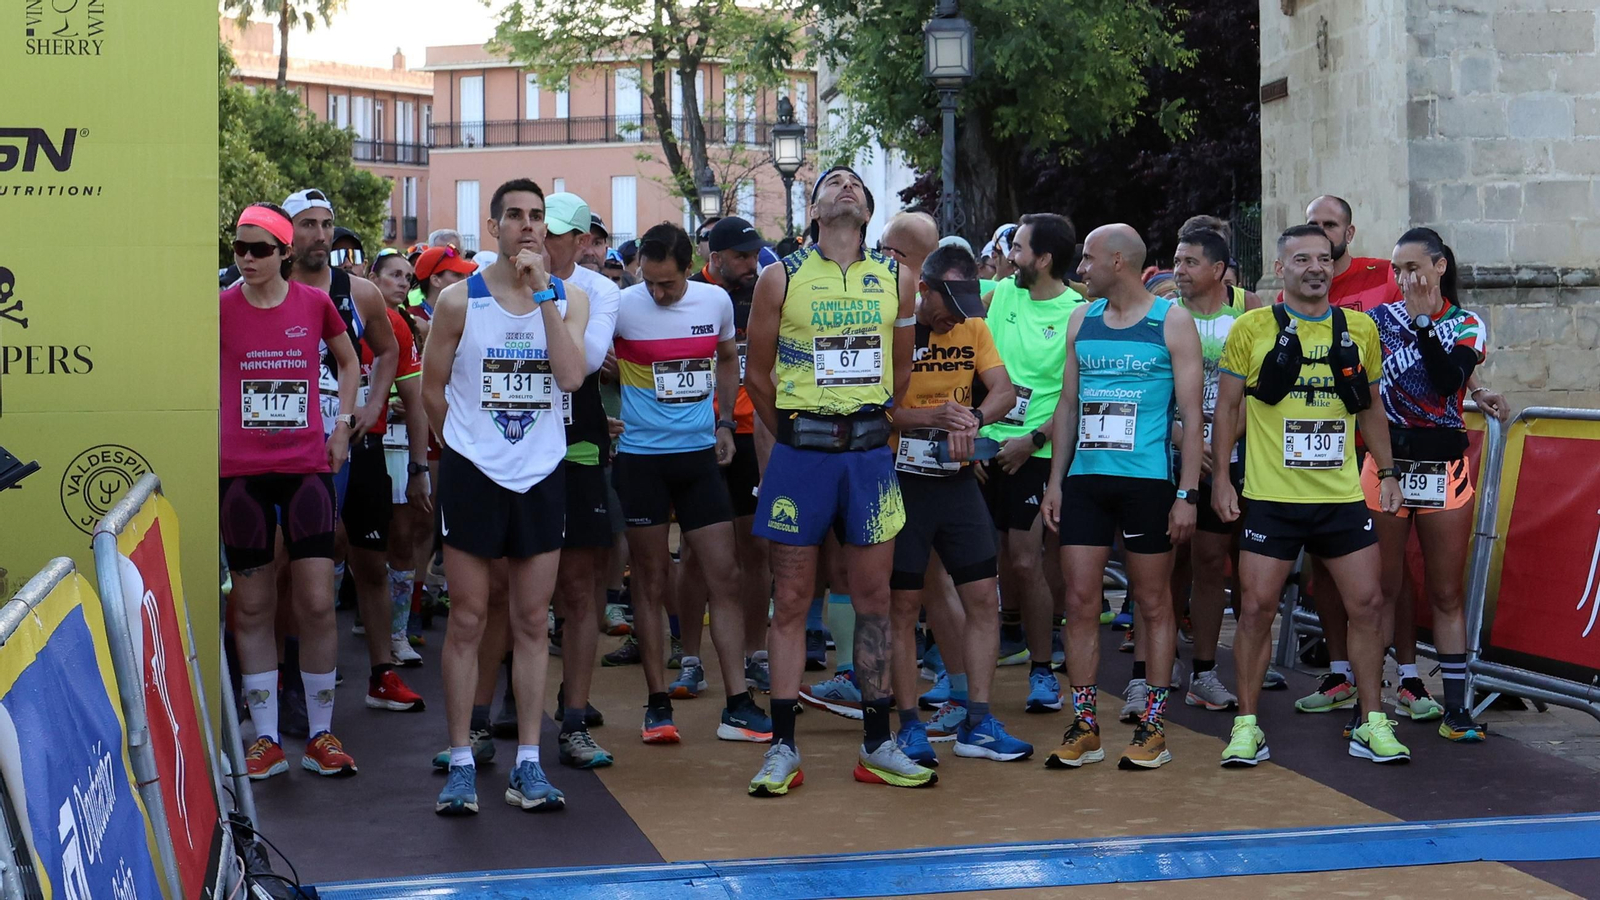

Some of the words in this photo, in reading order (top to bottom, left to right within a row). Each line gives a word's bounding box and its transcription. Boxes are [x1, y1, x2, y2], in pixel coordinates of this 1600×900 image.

[26, 38, 104, 55] SHERRY
[811, 300, 863, 312] CANILLAS
[867, 300, 880, 310] DE
[811, 311, 882, 326] ALBAIDA
[690, 324, 714, 335] 226ERS
[2, 344, 94, 374] PERS
[246, 350, 283, 358] atletismo
[286, 349, 302, 357] club
[840, 350, 860, 367] 67
[240, 359, 307, 370] MANCHATHON
[1080, 354, 1151, 371] NutreTec
[503, 373, 532, 391] 131
[676, 372, 695, 388] 20
[262, 394, 290, 410] 117
[1098, 415, 1105, 432] 1
[1304, 434, 1332, 451] 130
[1401, 473, 1428, 490] 159
